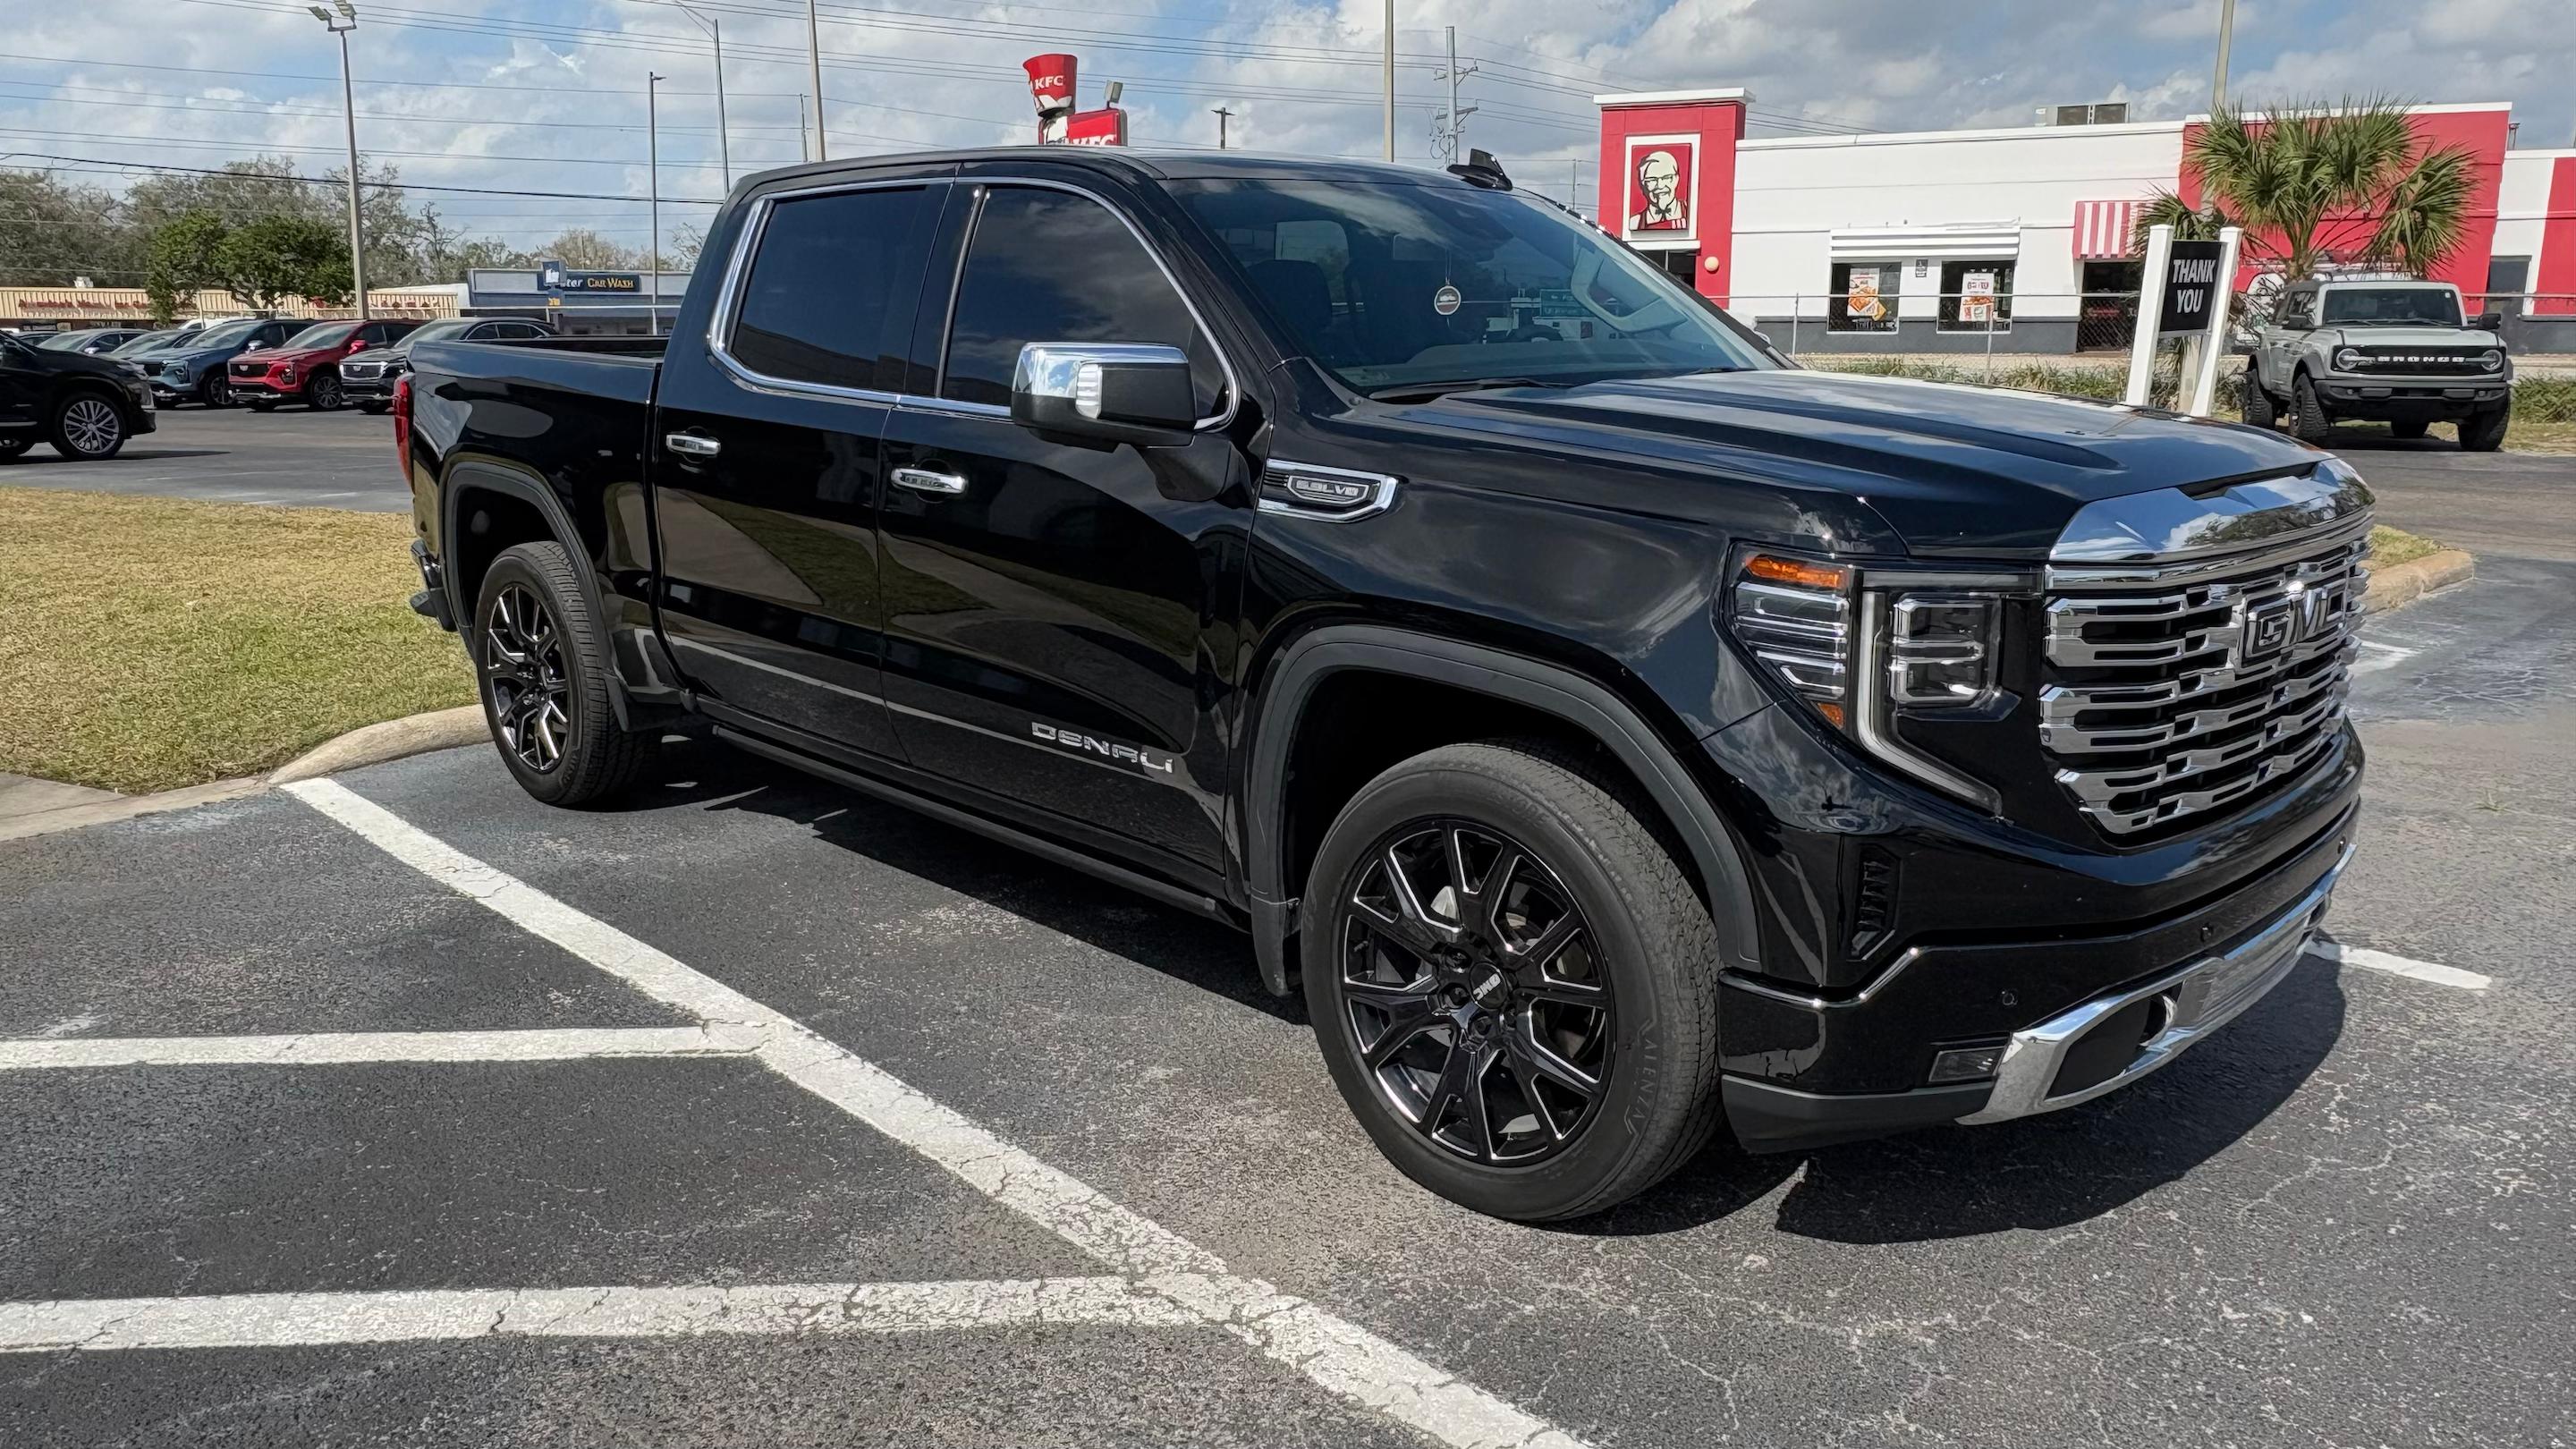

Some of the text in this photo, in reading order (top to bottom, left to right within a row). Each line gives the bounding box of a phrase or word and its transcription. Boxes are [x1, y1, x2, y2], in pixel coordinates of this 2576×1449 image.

[1035, 75, 1063, 89] KFC
[2173, 259, 2216, 284] THANK
[2176, 289, 2204, 313] YOU
[2244, 579, 2347, 658] GMC
[1031, 722, 1174, 774] DENALI
[1473, 973, 1501, 1001] GMC
